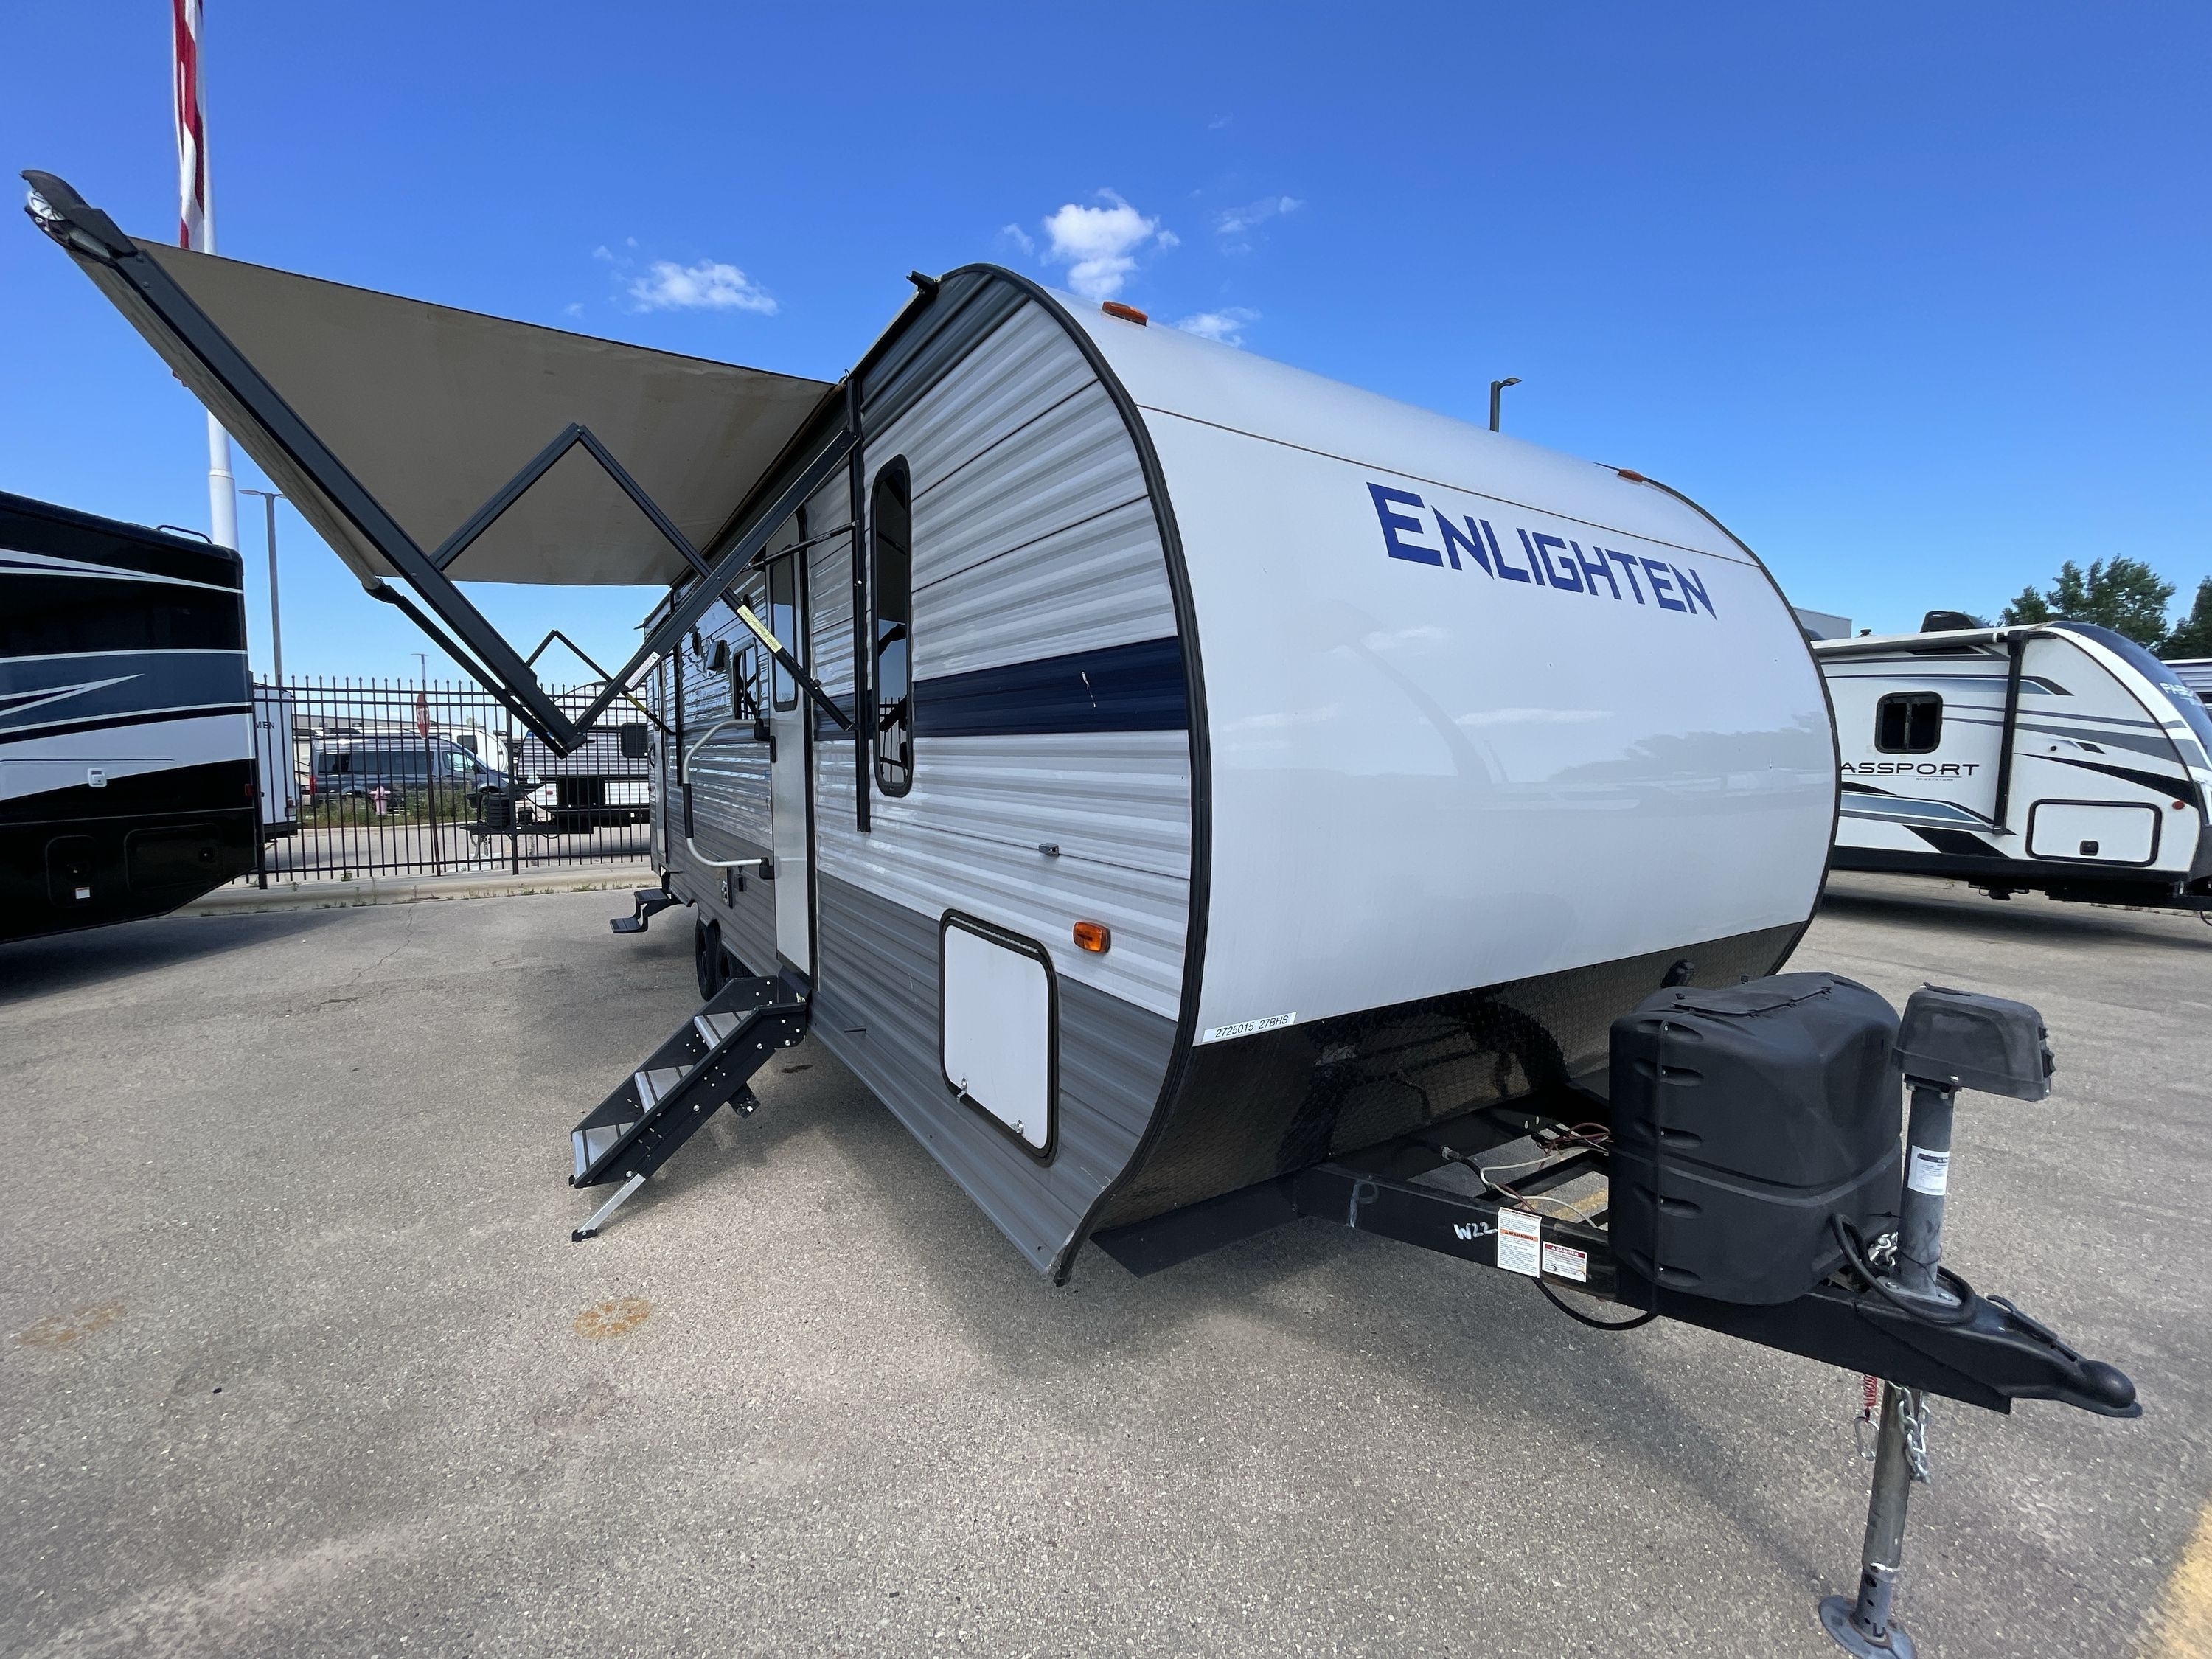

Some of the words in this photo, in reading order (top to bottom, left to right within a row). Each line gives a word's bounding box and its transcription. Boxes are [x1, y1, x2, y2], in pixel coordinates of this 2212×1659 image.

[1366, 481, 1718, 621] ENLIGHTEN
[1215, 1022, 1255, 1038] 2725015
[1259, 1015, 1289, 1029] 27BHS
[1453, 1221, 1498, 1240] W22
[1555, 1246, 1579, 1256] DANGER
